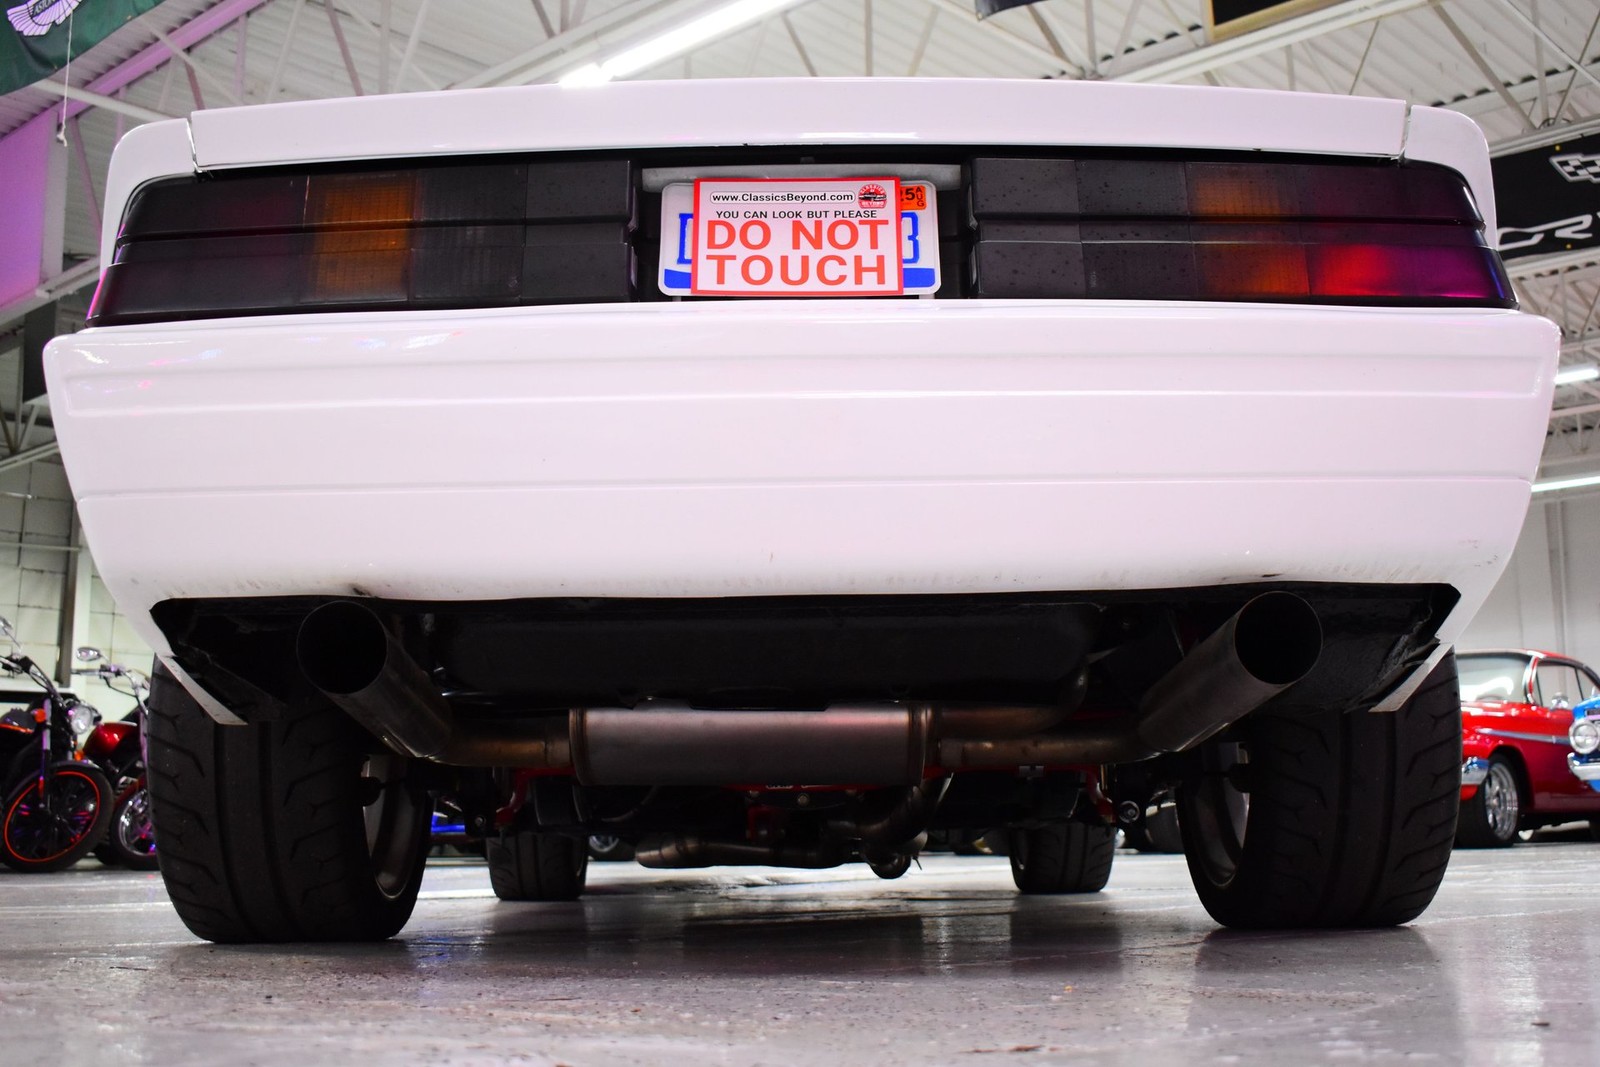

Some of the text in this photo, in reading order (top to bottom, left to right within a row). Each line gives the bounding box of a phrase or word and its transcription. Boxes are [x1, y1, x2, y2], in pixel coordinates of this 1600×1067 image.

[712, 192, 854, 203] www.ClassicsBeyond.com
[716, 210, 877, 219] YOU CAN LOOK BUT PLEASE
[707, 220, 772, 250] DO
[792, 220, 889, 250] NOT
[706, 255, 886, 286] TOUCH
